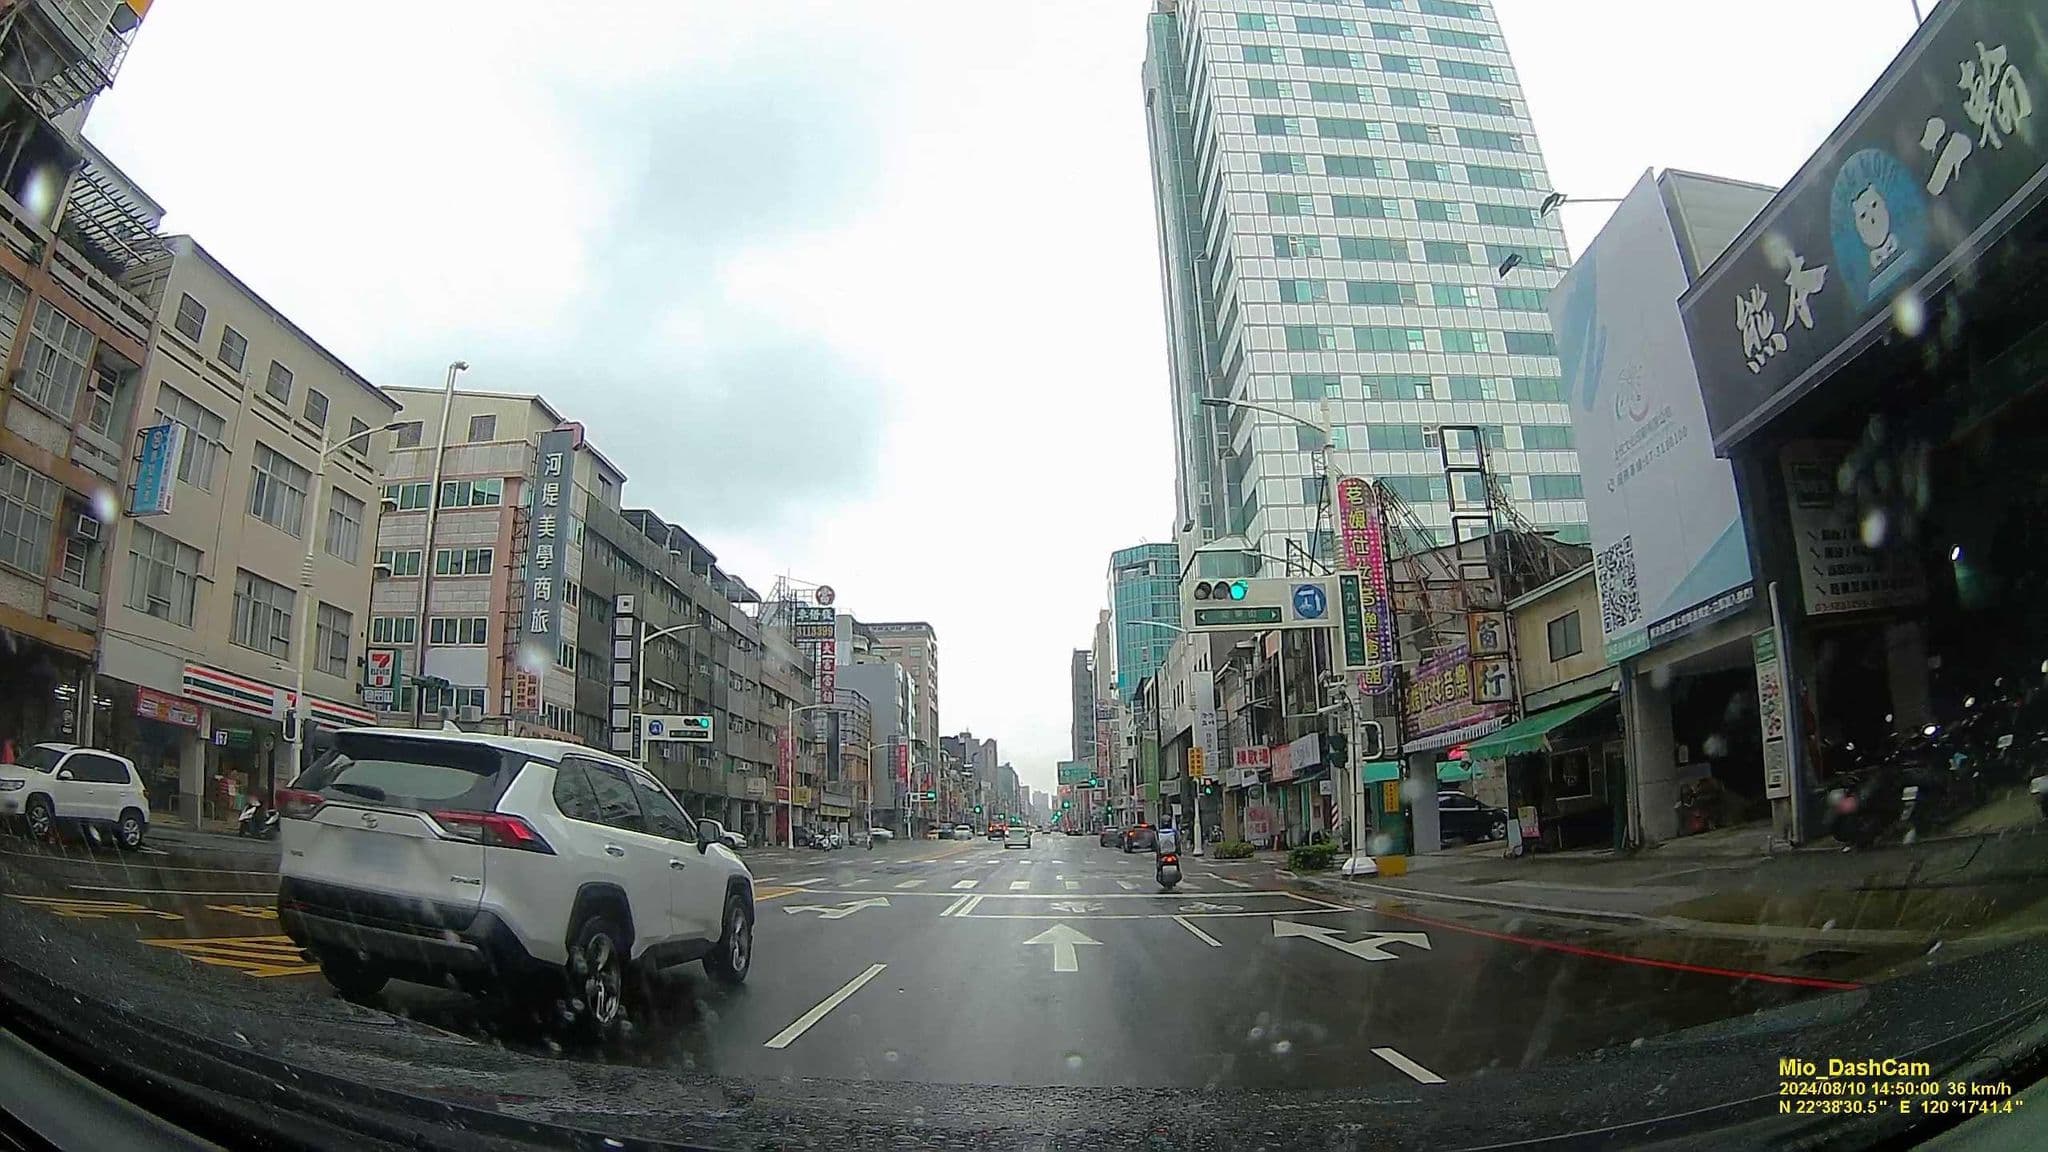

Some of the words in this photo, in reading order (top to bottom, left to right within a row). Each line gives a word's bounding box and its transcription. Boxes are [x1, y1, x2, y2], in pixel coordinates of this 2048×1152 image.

[1734, 250, 1829, 376] 熊本
[530, 451, 564, 634] 河堤美學商旅
